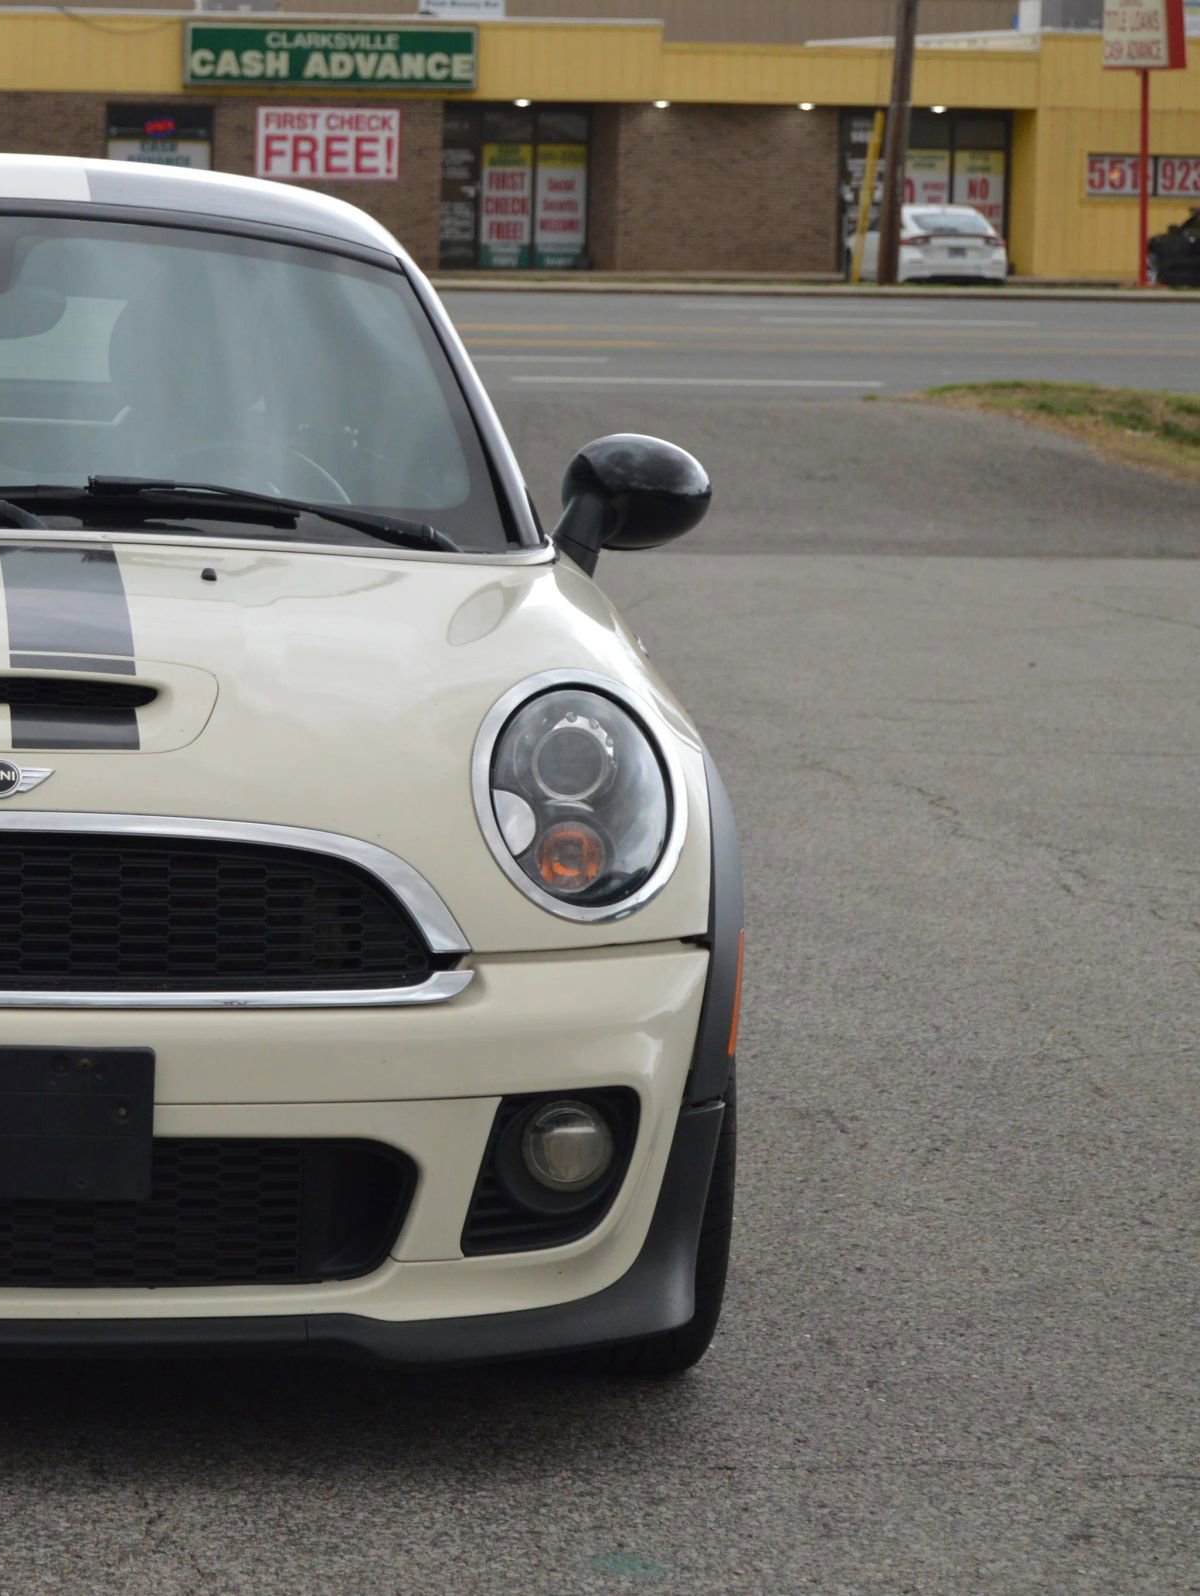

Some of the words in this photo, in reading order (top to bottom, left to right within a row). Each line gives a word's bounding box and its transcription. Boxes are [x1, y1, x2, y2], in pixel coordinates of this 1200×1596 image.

[265, 31, 399, 50] CLARKSVILLE
[191, 49, 290, 78] CASH
[303, 51, 473, 80] ADVANCE
[264, 112, 320, 131] FIRST
[325, 113, 393, 131] CHECK
[263, 135, 394, 174] FREE!
[488, 171, 525, 191] FIRST
[485, 196, 529, 215] CHECK
